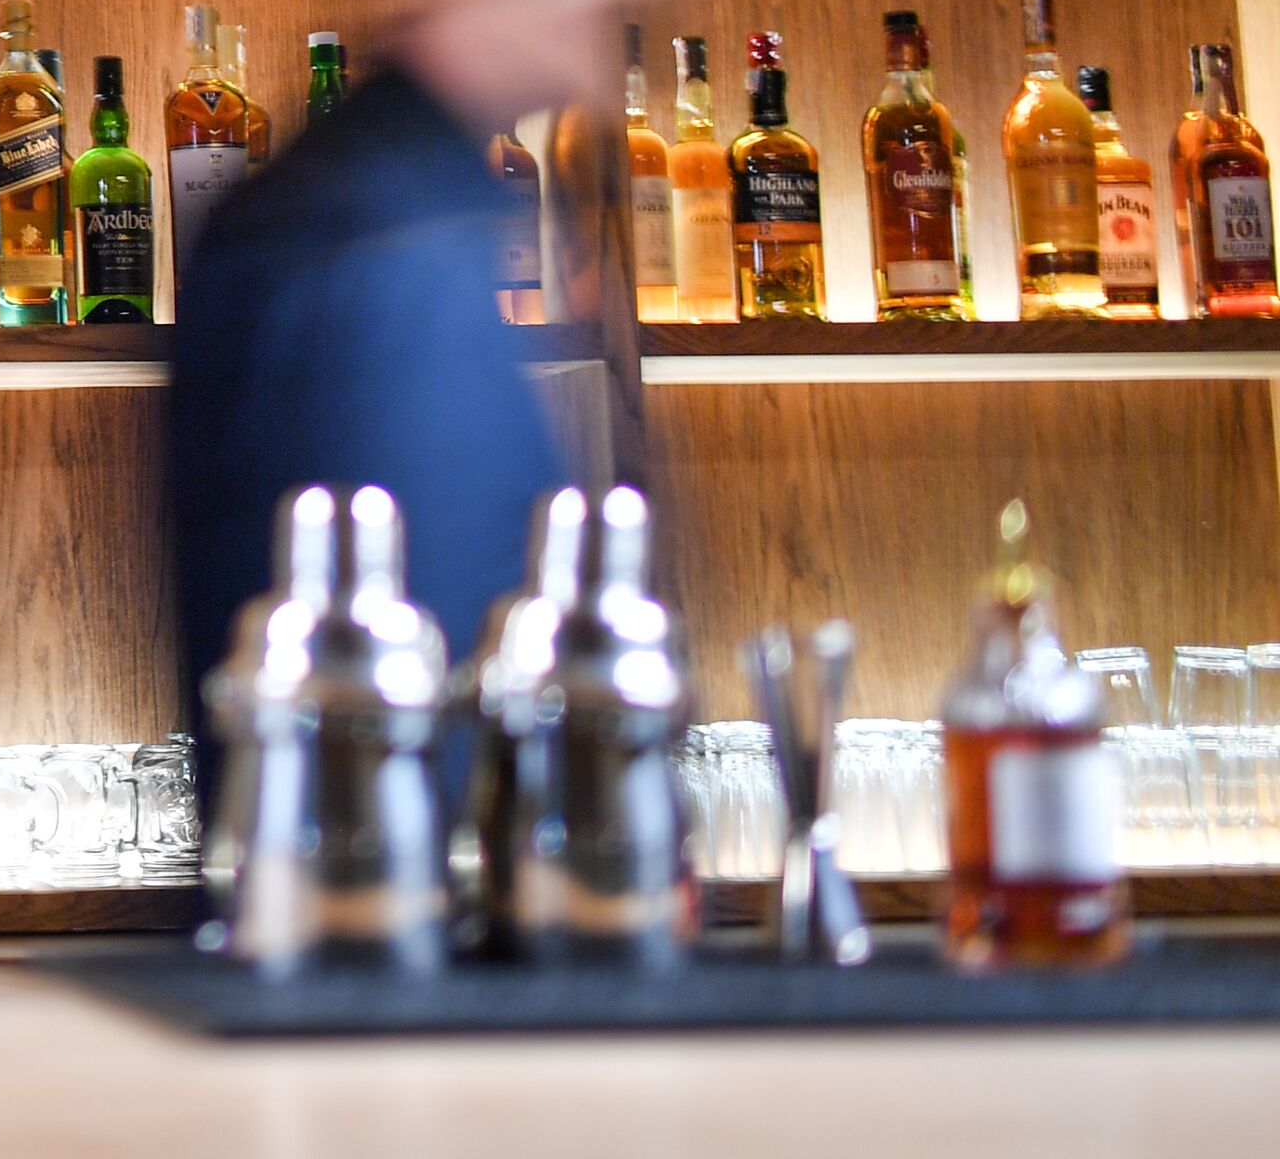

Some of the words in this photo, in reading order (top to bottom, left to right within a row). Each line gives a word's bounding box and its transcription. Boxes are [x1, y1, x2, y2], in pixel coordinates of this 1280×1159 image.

[0, 146, 27, 165] Blue
[25, 134, 59, 156] Label
[749, 176, 818, 192] HIGHLAND
[768, 190, 806, 206] PARK
[1224, 216, 1263, 239] 101
